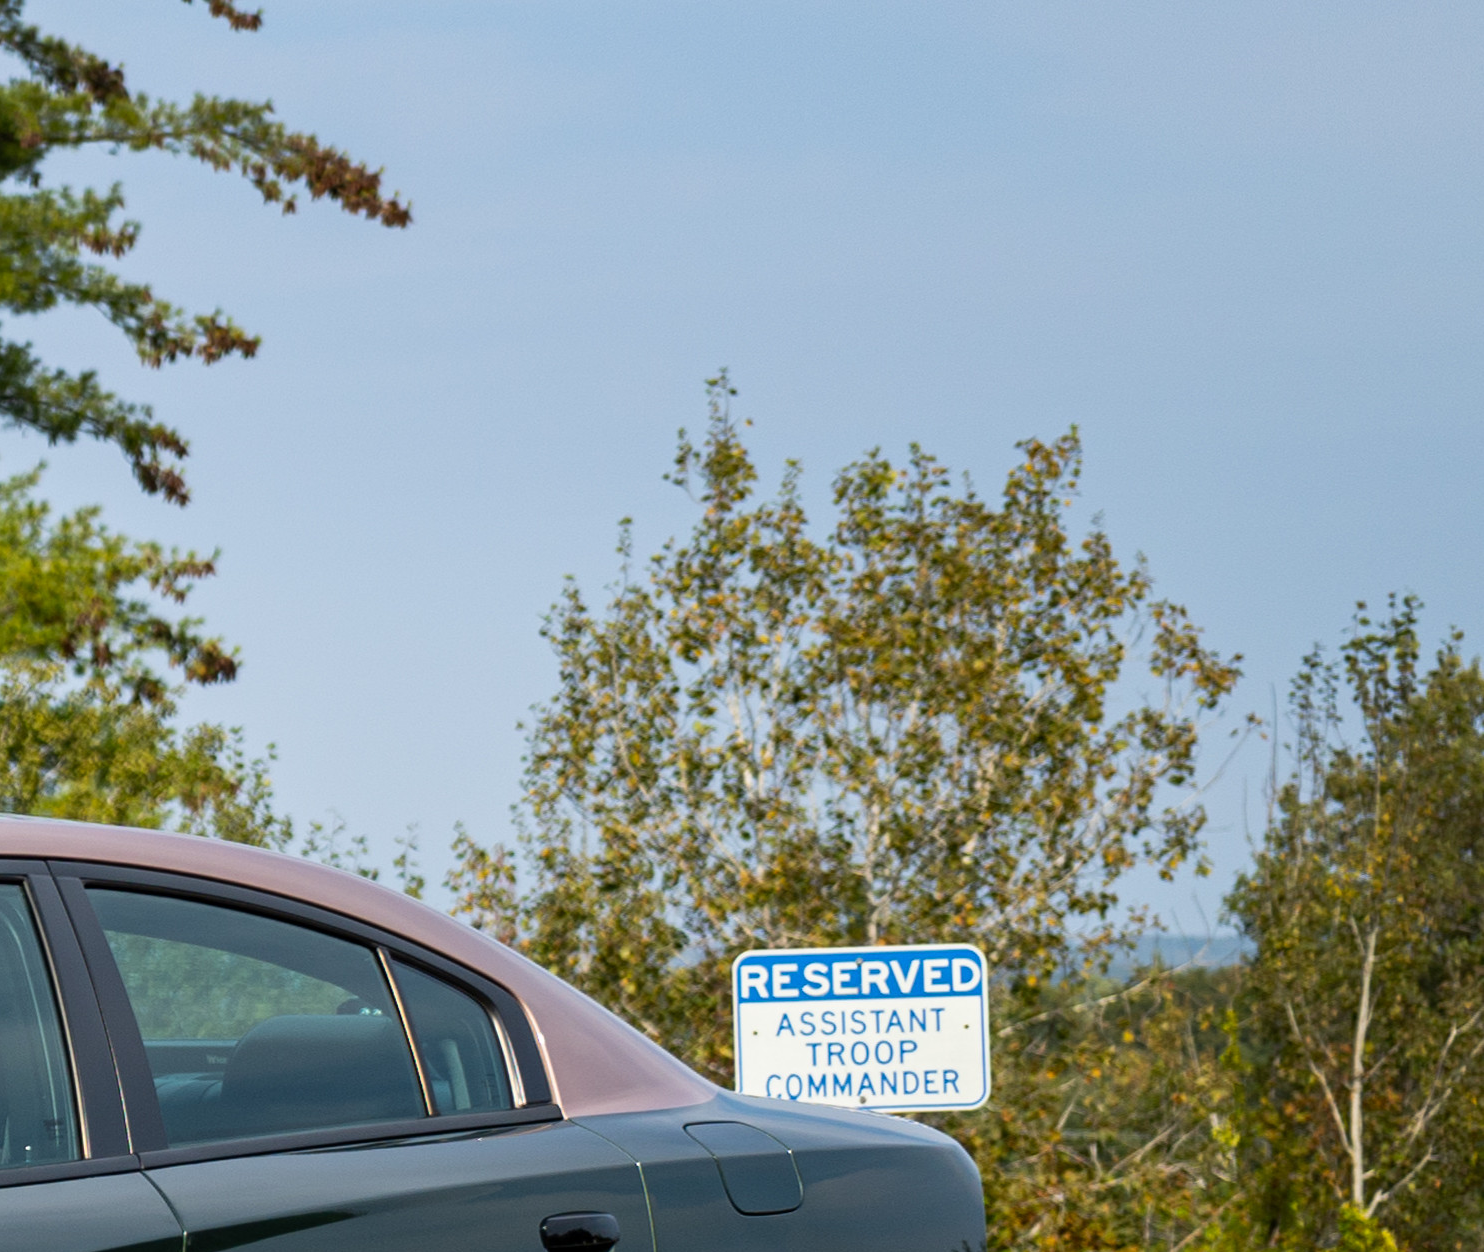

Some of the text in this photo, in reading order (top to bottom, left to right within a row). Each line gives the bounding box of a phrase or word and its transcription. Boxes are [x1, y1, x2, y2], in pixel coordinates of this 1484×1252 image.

[740, 958, 981, 999] RESERVED
[776, 1008, 945, 1037] ASSISTANT
[806, 1040, 918, 1066] TROOP
[766, 1070, 959, 1100] COMMANDER
